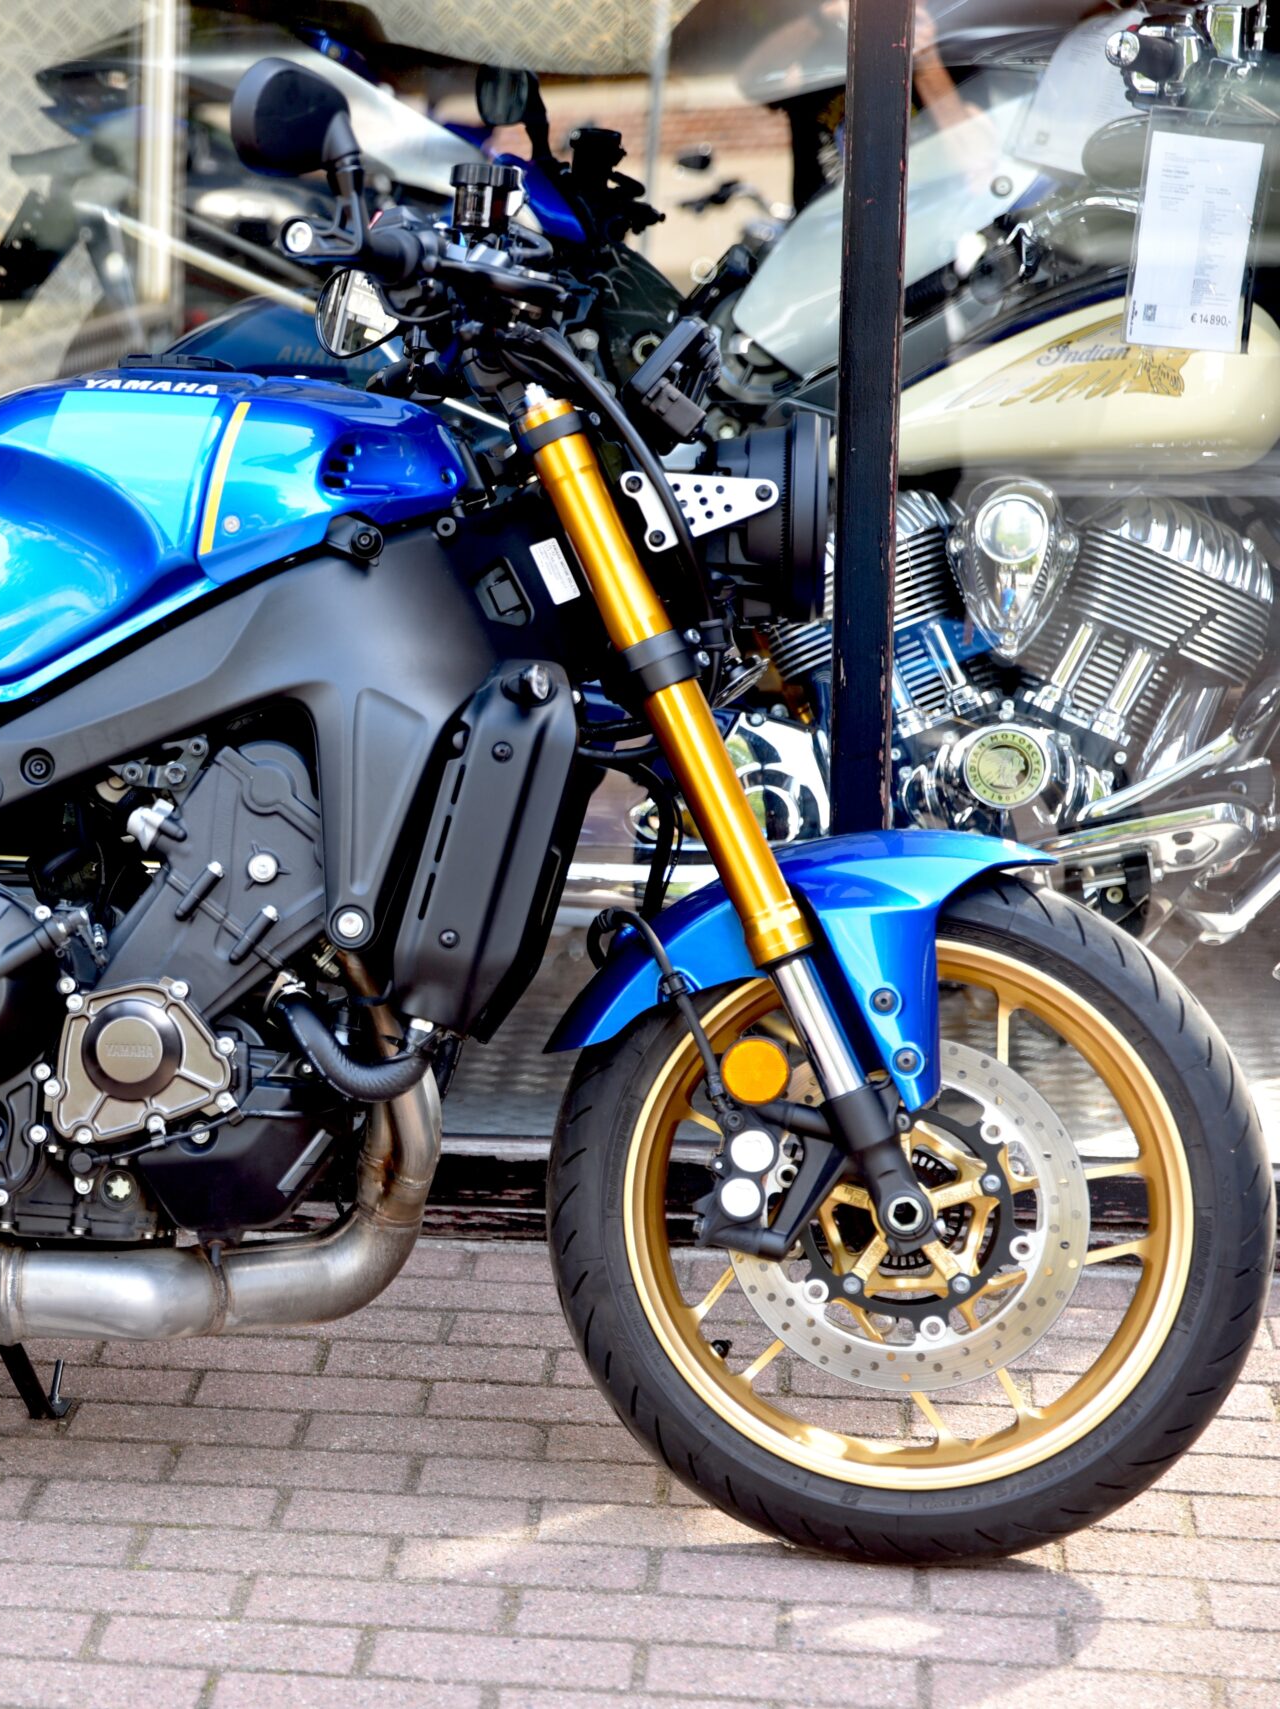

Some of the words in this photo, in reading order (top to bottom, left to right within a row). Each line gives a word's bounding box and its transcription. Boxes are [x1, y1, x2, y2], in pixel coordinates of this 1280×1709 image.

[1036, 340, 1131, 367] Indian
[84, 378, 219, 396] YAMAHA
[104, 1042, 154, 1059] YAMAHA
